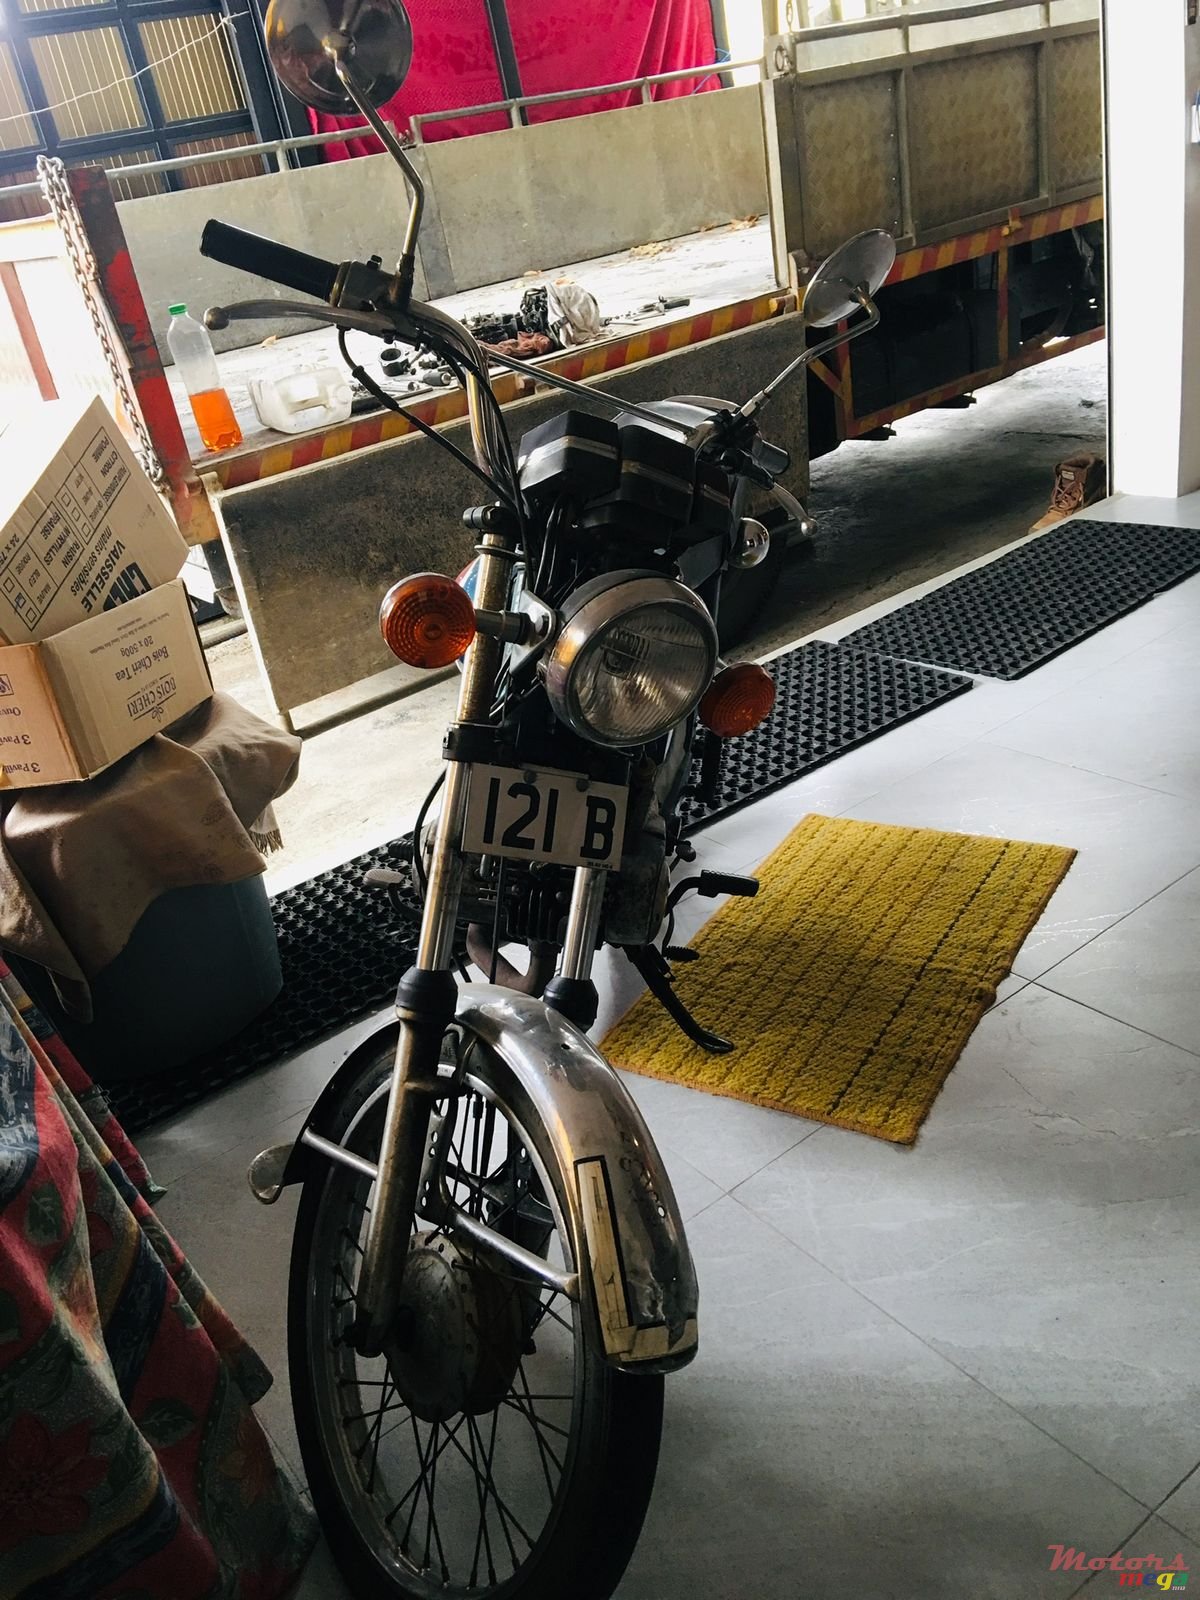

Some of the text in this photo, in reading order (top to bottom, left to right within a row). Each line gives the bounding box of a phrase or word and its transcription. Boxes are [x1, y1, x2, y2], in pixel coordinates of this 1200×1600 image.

[100, 450, 118, 477] CITRON
[40, 511, 61, 540] FRAISE
[43, 525, 71, 566] MYRTILLES
[61, 540, 81, 568] RAISIN
[70, 525, 112, 596] mains sensibles
[81, 539, 126, 613] VAISSELLE
[144, 635, 154, 648] 20
[152, 646, 169, 662] Bois
[115, 667, 133, 681] Tea
[127, 677, 177, 717] BOIS CHERI
[0, 706, 21, 716] Ouv
[21, 735, 31, 745] 3
[31, 763, 40, 773] 3
[483, 777, 617, 861] 121 B
